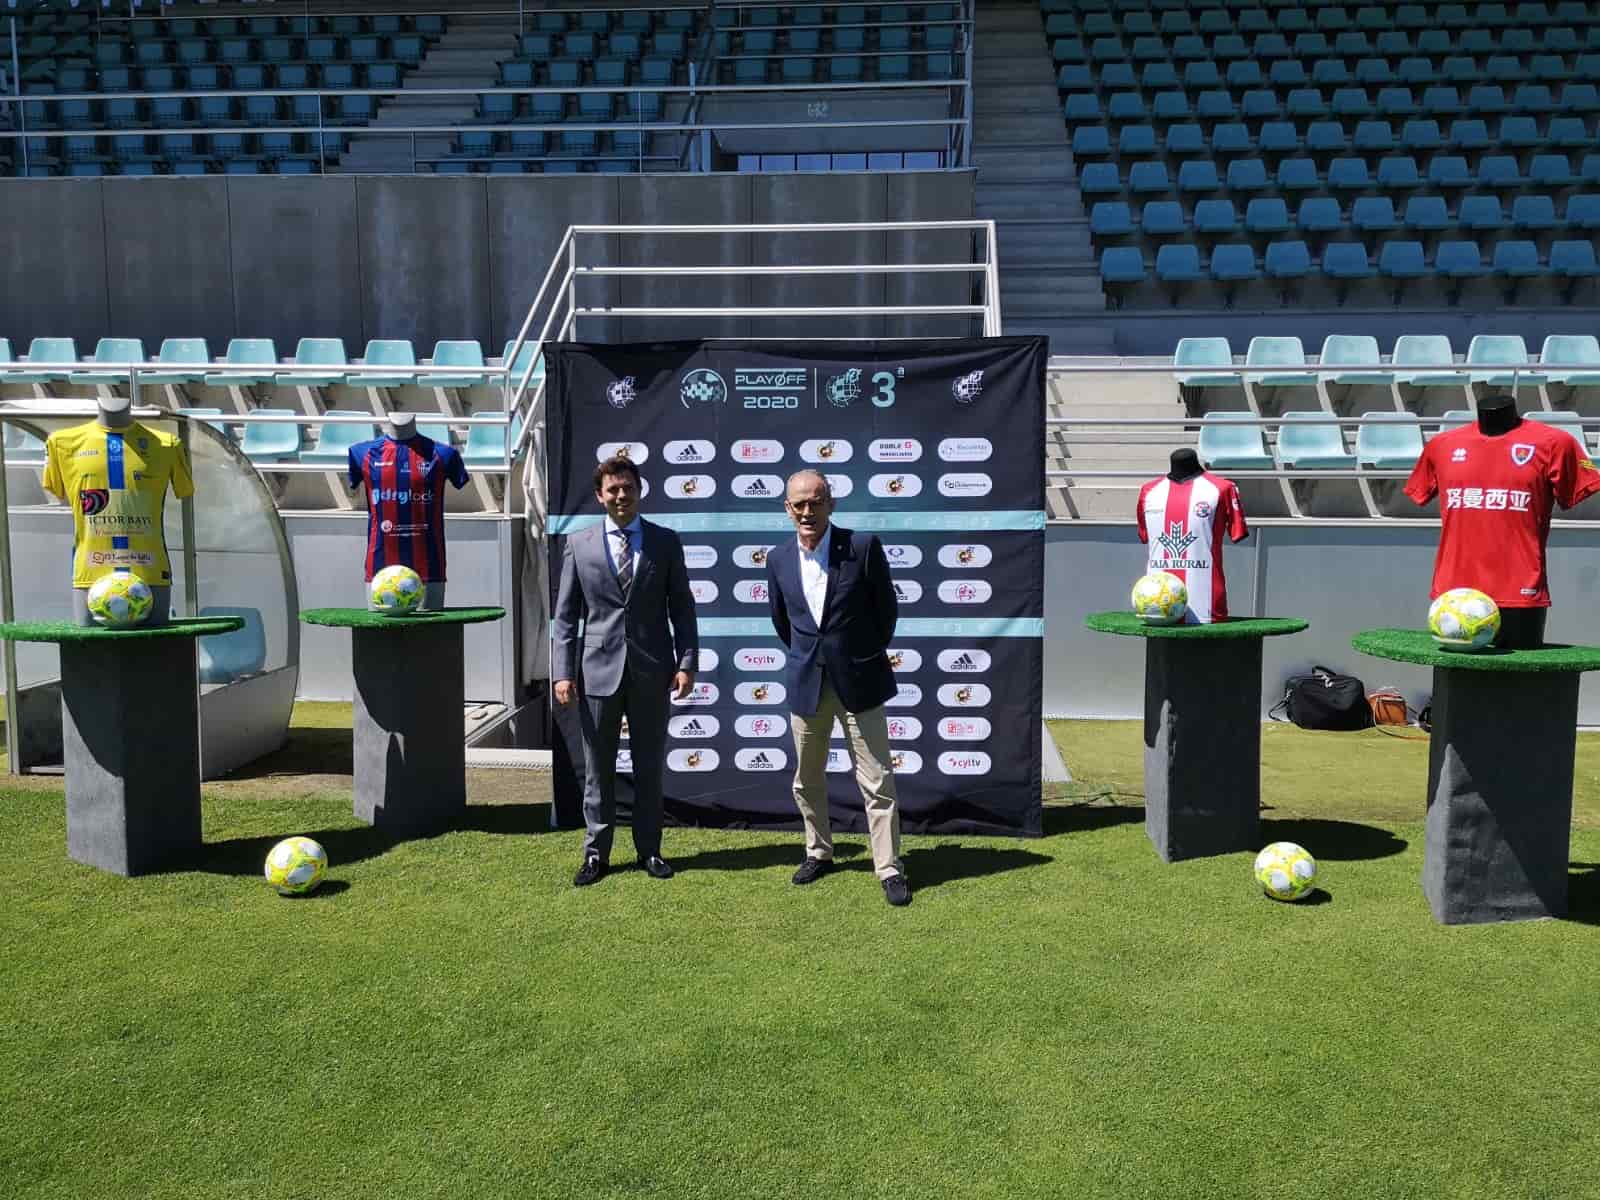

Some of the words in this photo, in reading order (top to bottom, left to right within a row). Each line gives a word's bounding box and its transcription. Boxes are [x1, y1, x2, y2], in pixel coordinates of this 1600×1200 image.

[735, 374, 807, 386] PLAYOFF
[743, 396, 799, 408] 2020
[1446, 487, 1532, 512] 努曼西亚
[89, 515, 125, 525] ICTOR
[1172, 559, 1209, 569] RURAL
[747, 761, 774, 769] adidas
